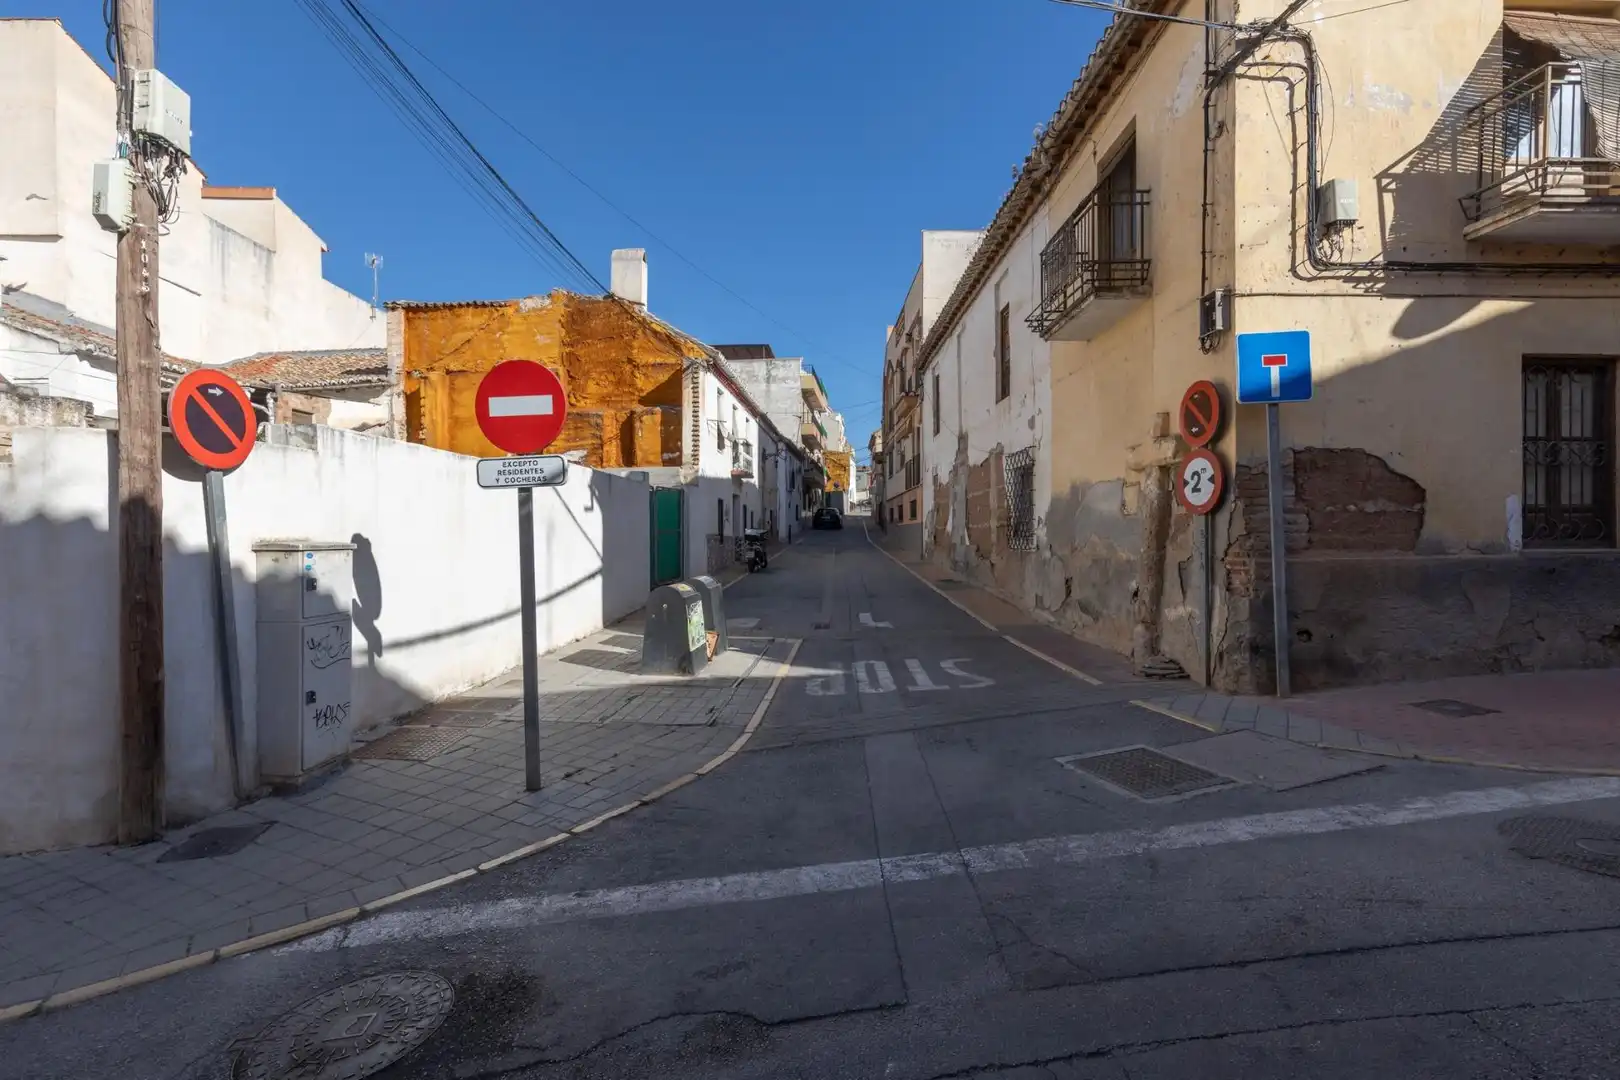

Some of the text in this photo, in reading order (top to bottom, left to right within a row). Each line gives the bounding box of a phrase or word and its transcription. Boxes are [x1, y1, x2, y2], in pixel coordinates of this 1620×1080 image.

[502, 460, 539, 468] EXCEPTO
[497, 468, 545, 476] RESIDENTES
[504, 476, 548, 484] COCHERAS
[805, 658, 996, 696] STOP
